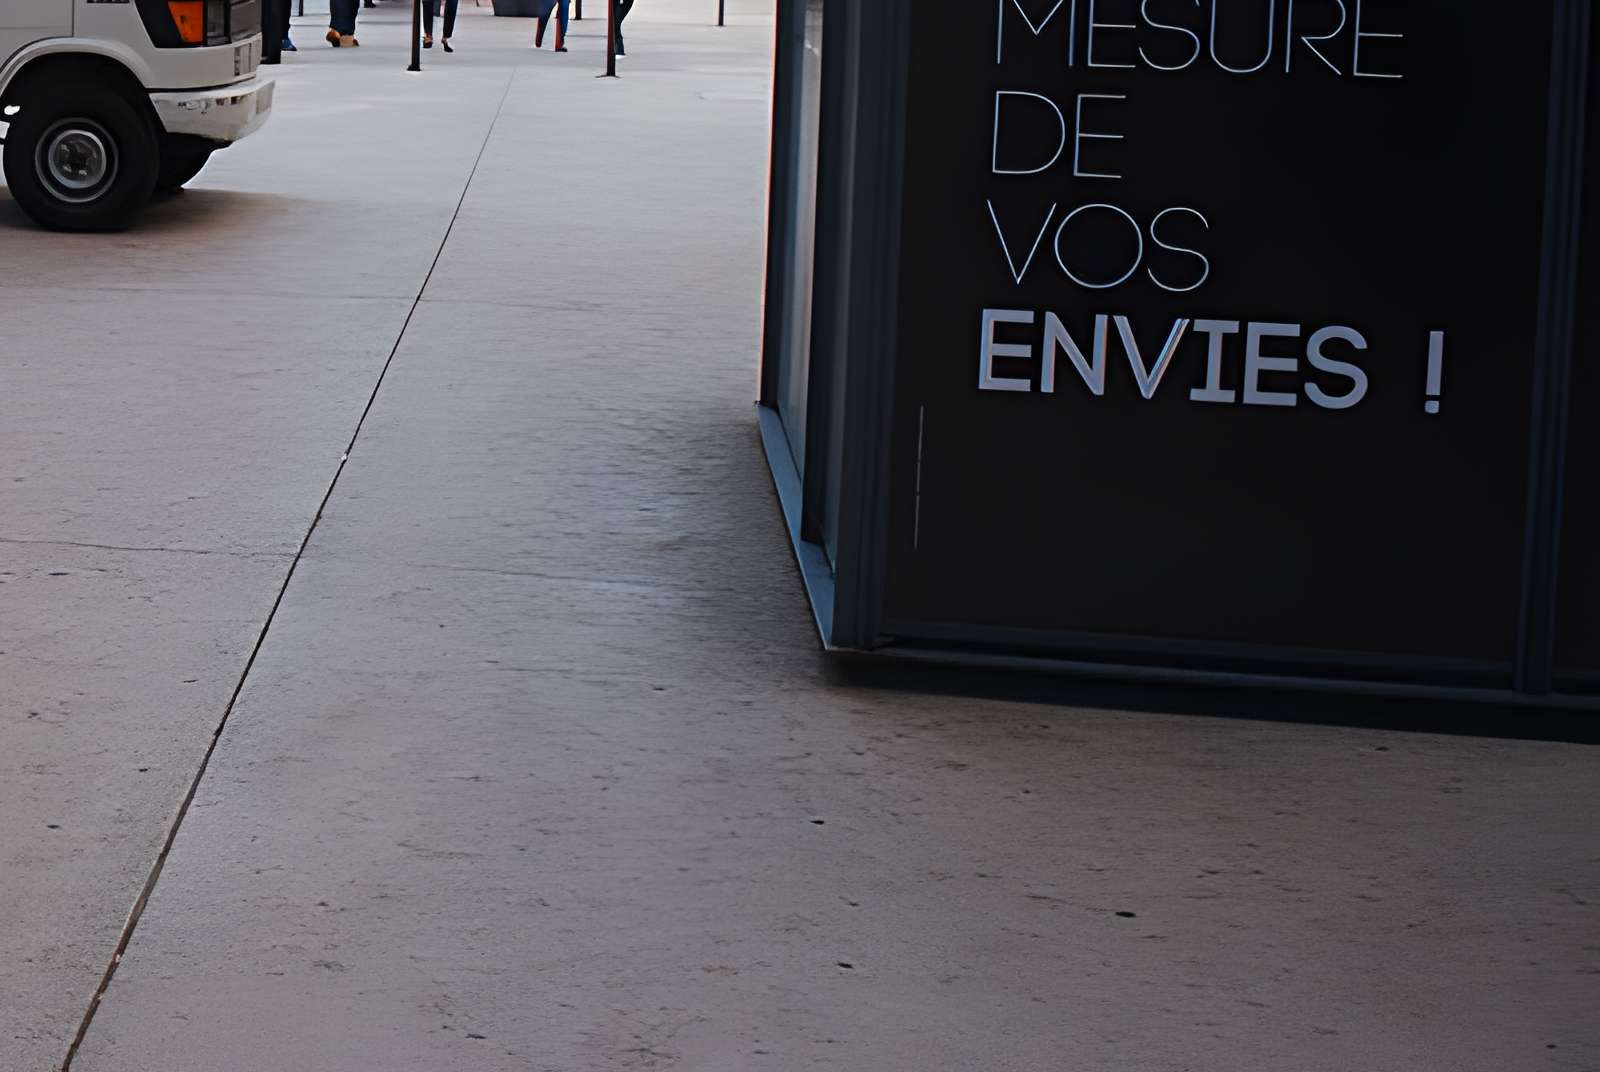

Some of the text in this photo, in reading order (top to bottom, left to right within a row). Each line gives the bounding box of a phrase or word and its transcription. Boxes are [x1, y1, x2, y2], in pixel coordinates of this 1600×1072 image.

[992, 90, 1127, 179] DE
[987, 199, 1210, 292] VOS
[978, 308, 1368, 409] ENVIES
